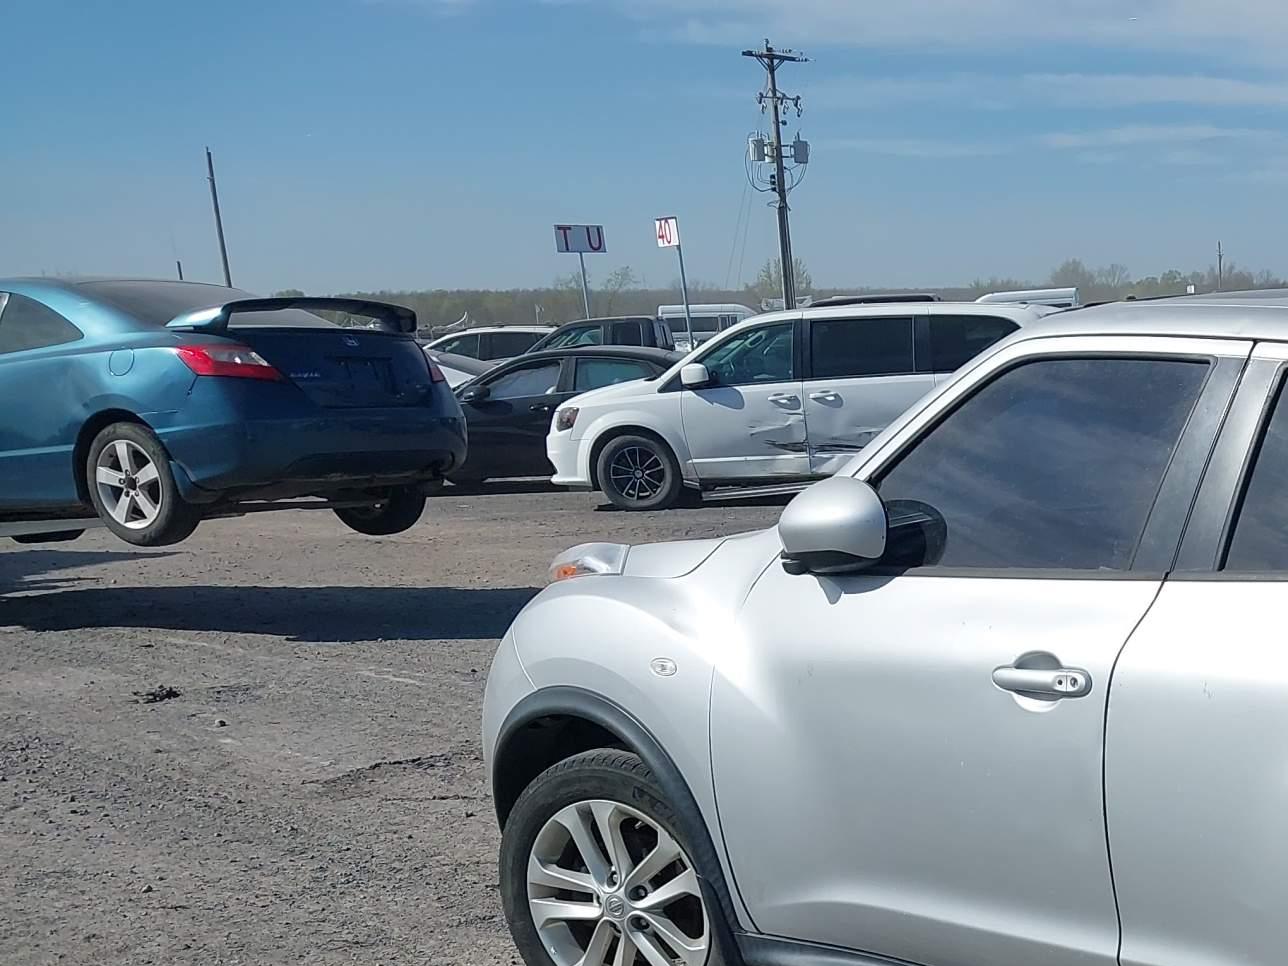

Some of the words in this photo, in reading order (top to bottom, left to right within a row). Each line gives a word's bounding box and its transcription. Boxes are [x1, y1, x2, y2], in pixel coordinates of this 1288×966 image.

[557, 226, 572, 252] T
[585, 225, 603, 251] U
[657, 219, 672, 245] 40
